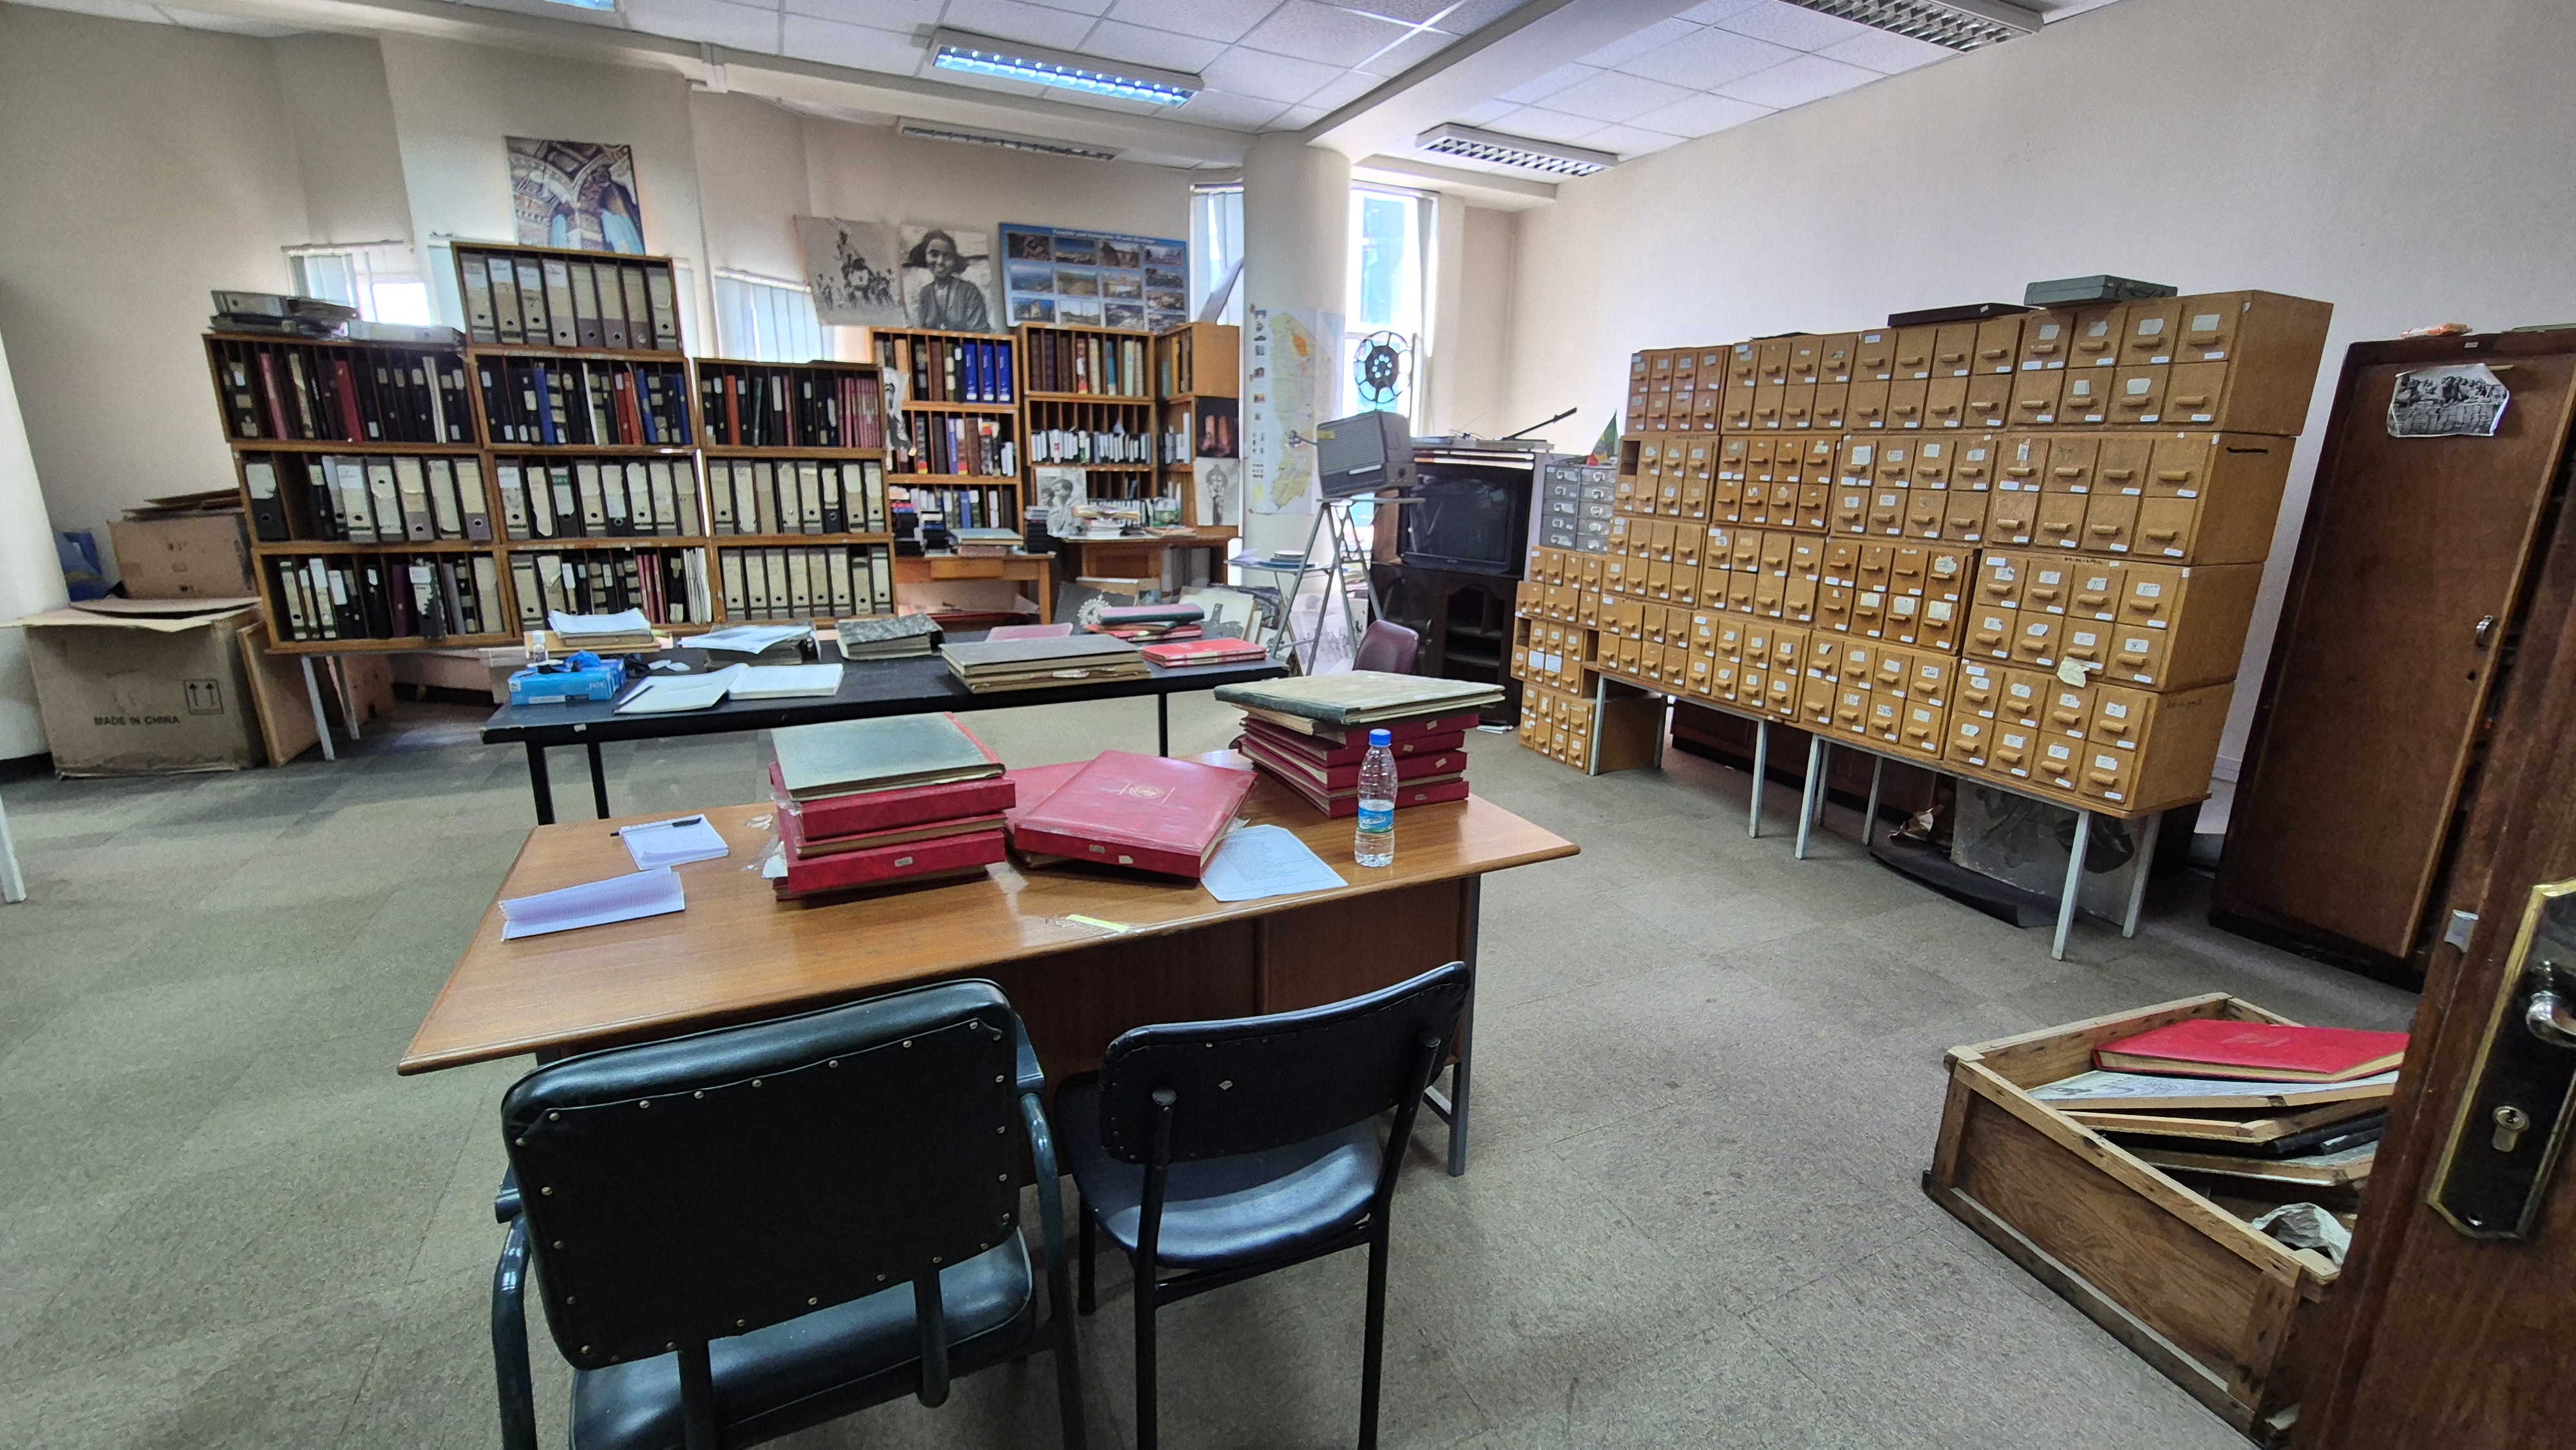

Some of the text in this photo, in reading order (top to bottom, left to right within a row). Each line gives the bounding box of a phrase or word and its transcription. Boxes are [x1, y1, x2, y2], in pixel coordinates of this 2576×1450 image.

[94, 715, 180, 726] MADE IN CHINA
